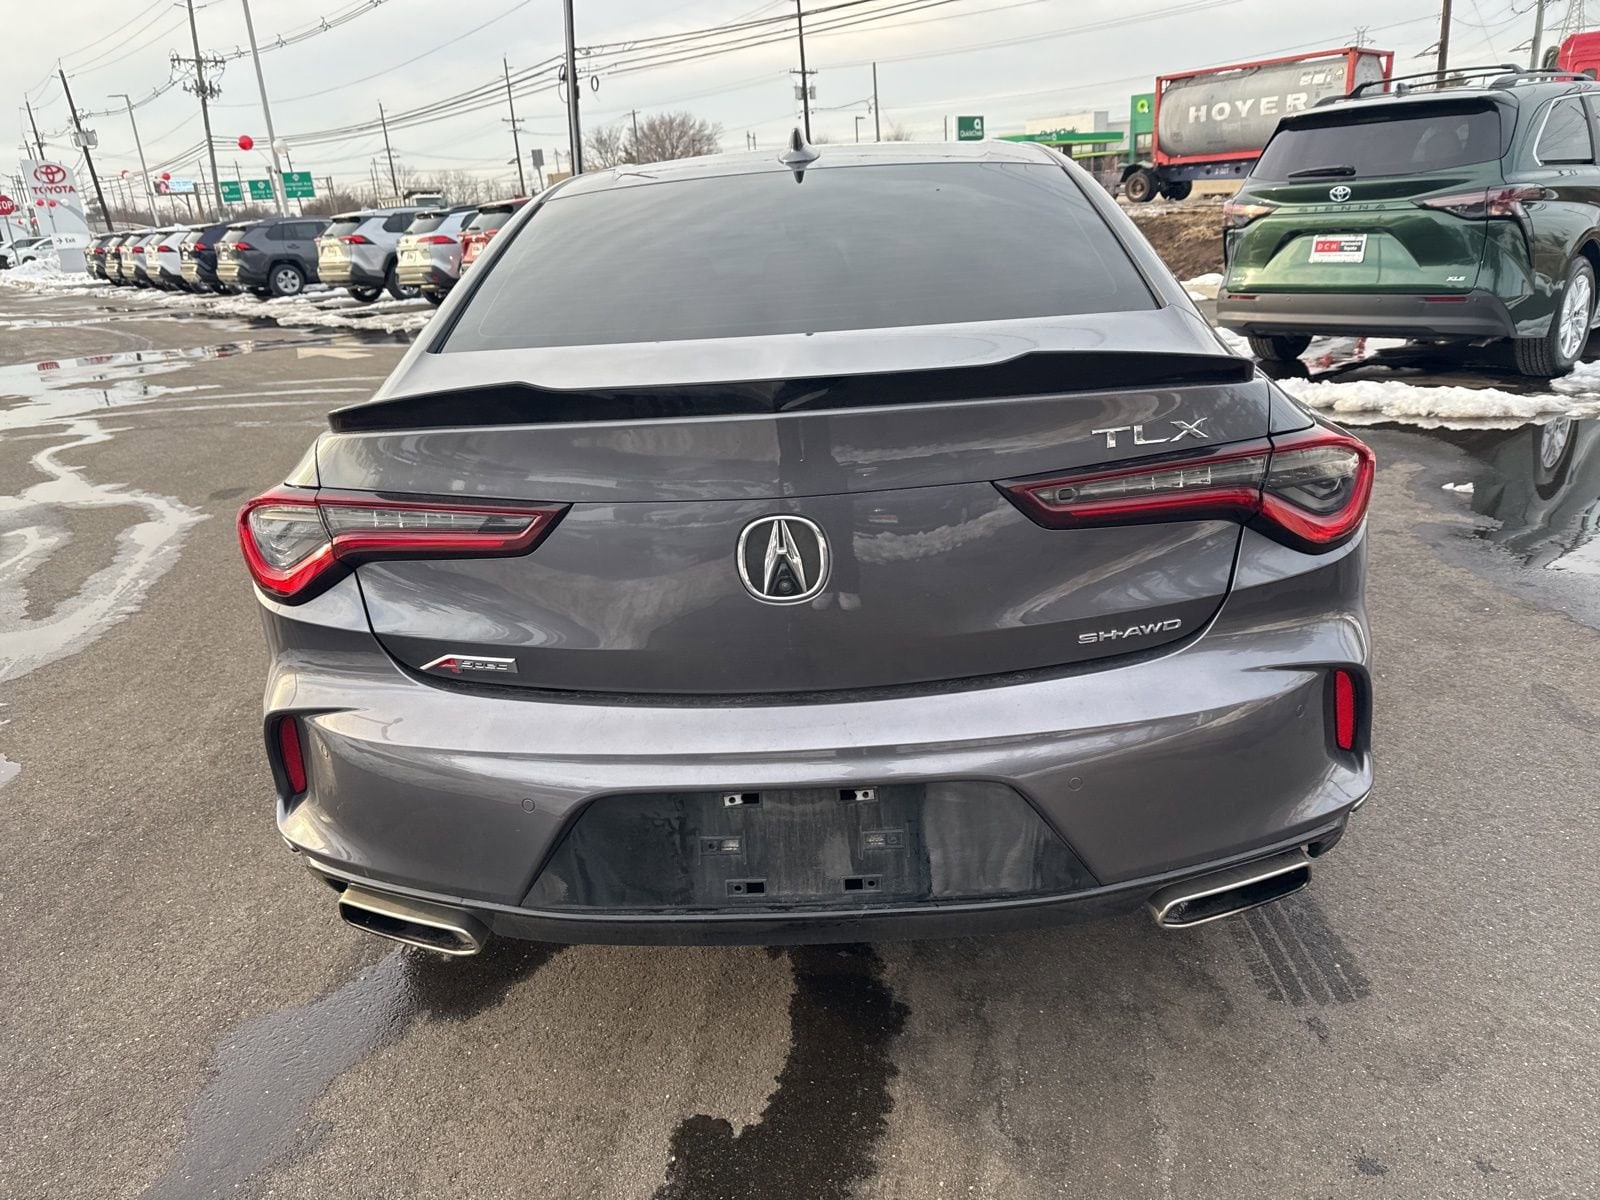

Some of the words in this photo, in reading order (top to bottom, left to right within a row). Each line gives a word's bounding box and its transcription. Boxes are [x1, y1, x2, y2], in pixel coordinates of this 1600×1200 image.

[1188, 92, 1308, 124] HOYER
[32, 185, 76, 195] TOYOTA
[1298, 204, 1386, 213] SIENNA
[1092, 417, 1208, 448] TLX
[1078, 618, 1182, 644] SH-AWD
